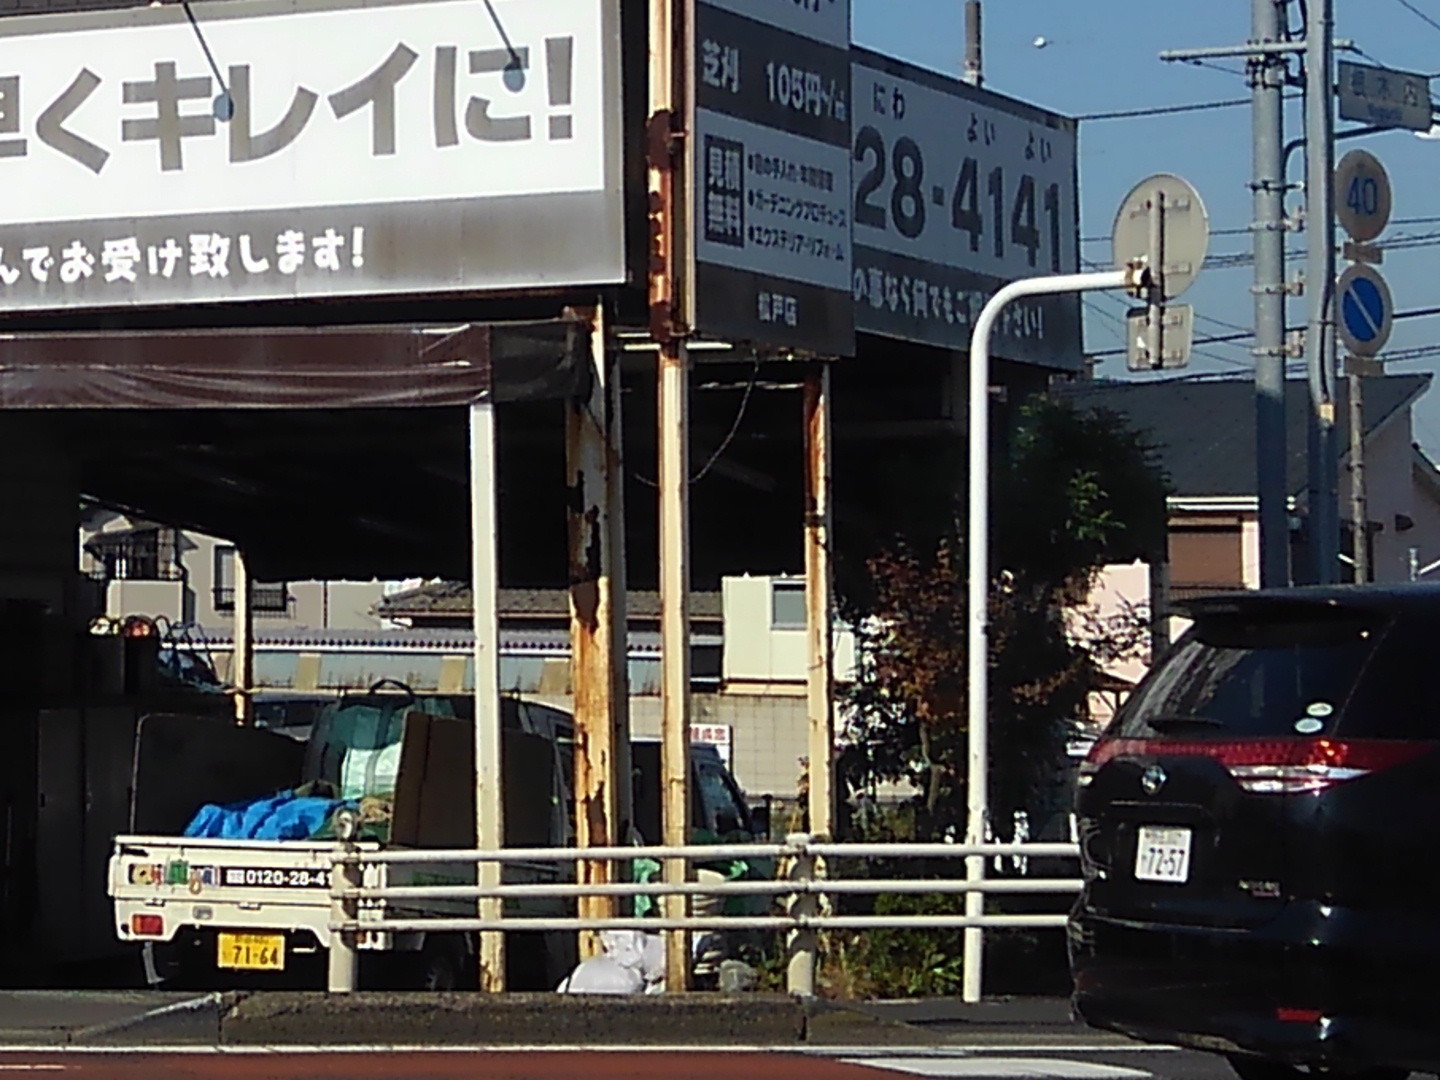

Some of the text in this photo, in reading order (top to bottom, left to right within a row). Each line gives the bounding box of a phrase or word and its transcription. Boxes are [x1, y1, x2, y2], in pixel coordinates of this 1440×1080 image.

[702, 39, 739, 93] 芝刈
[873, 82, 1052, 163] にわ よい よい
[1347, 176, 1379, 215] 40
[247, 869, 333, 886] 0120-28-41
